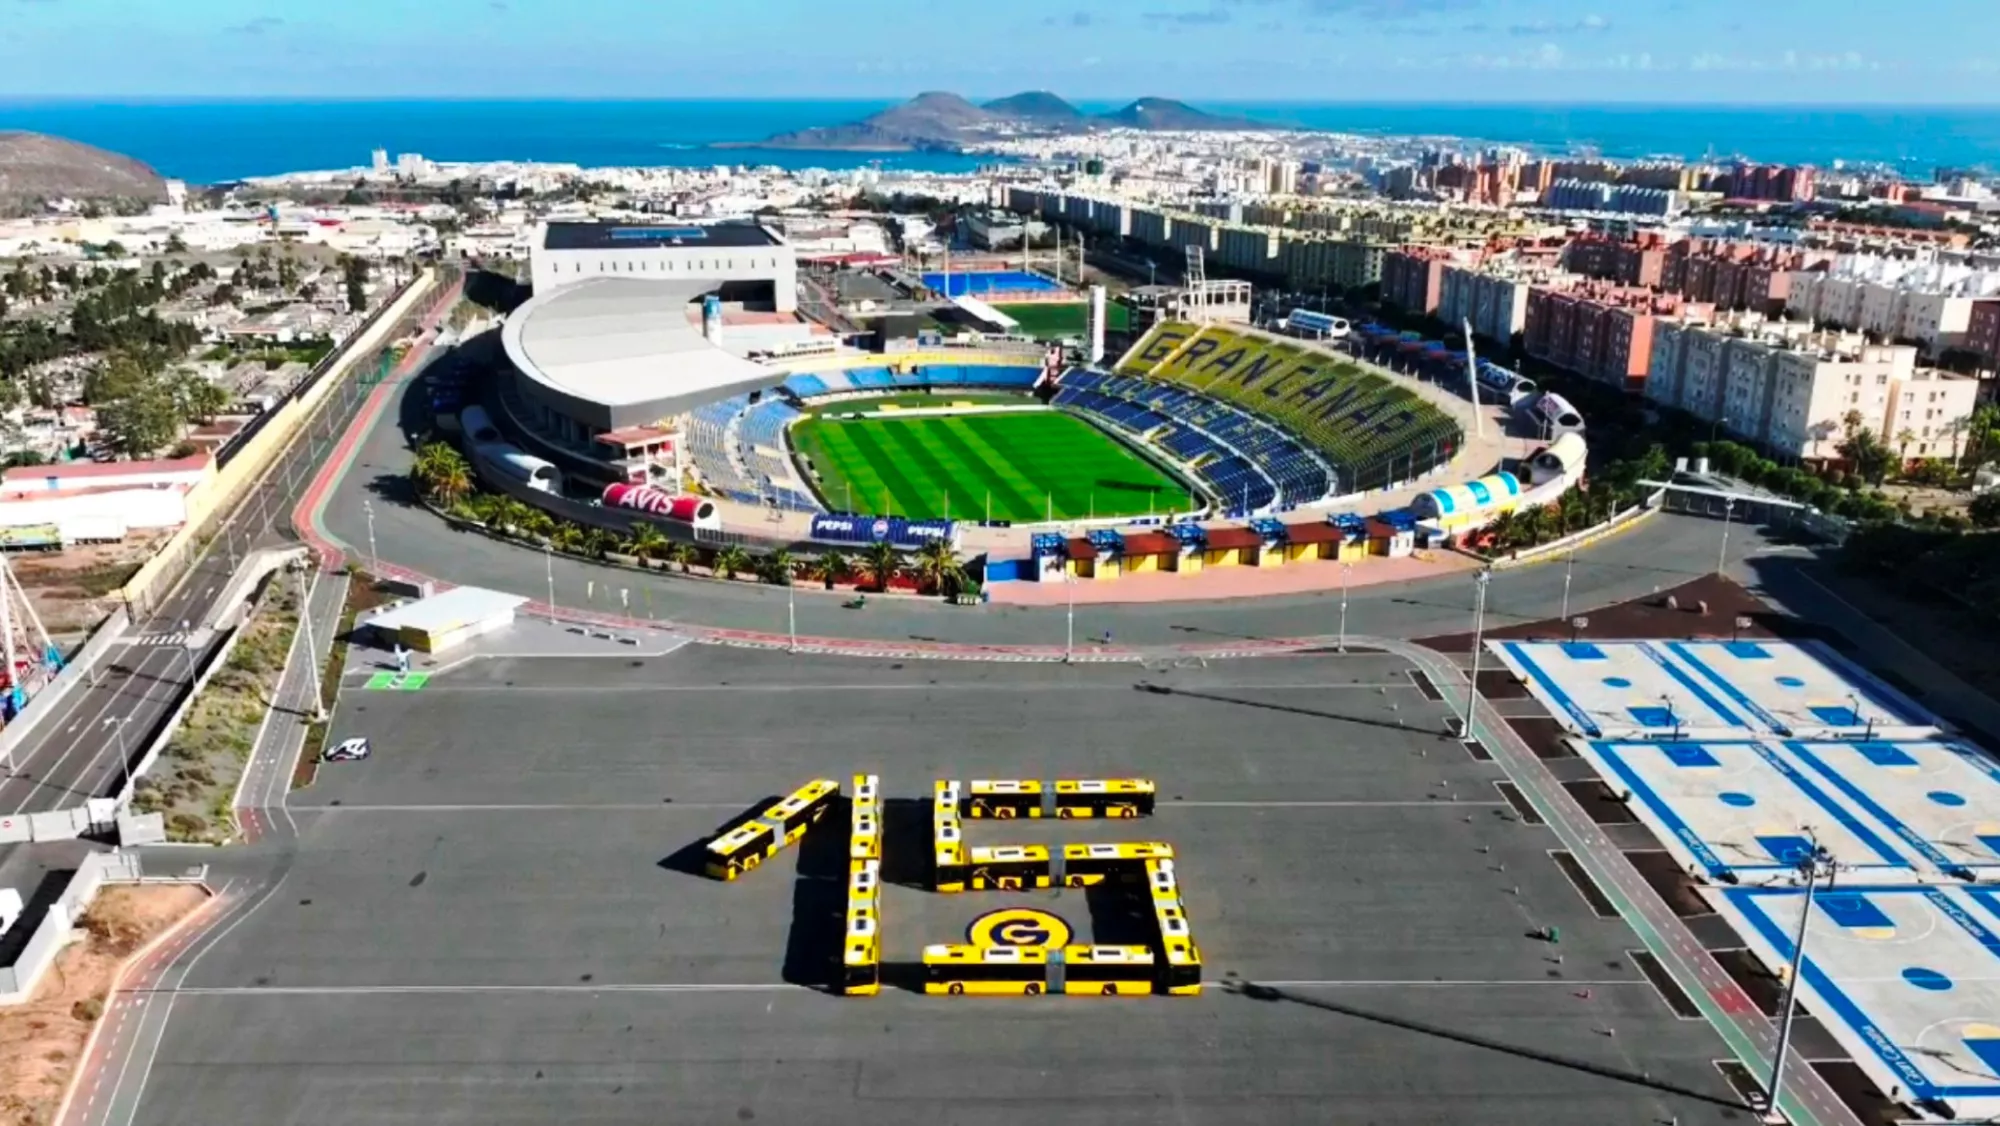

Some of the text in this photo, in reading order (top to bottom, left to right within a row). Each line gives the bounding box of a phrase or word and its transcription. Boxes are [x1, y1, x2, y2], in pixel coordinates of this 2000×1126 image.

[1141, 332, 1283, 389] GRAN
[619, 488, 674, 515] AVIS
[816, 520, 853, 531] PEPSI
[907, 525, 945, 537] PEPSI
